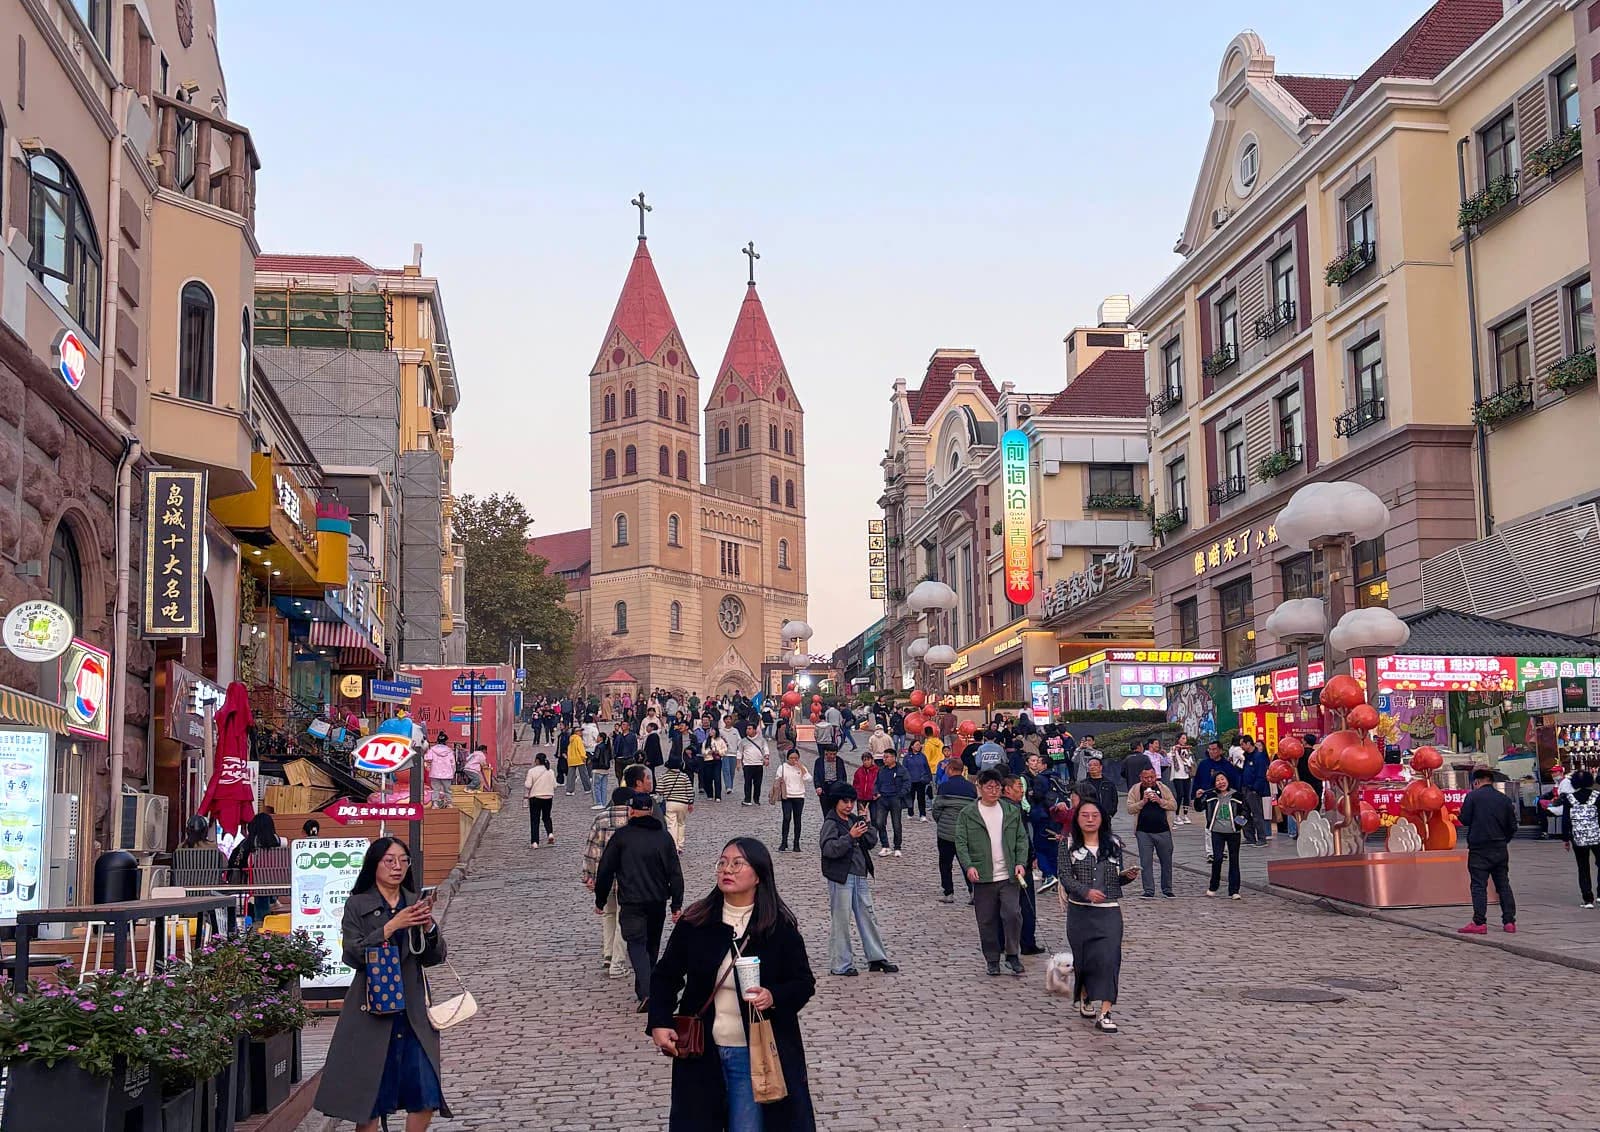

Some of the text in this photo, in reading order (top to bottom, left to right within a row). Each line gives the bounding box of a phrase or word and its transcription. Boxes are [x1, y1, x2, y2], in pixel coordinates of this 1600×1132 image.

[1007, 440, 1026, 510] 前海沿
[161, 484, 186, 622] 岛城十大名吃
[1009, 528, 1030, 591] 青岛菜
[364, 742, 404, 765] DQ
[338, 806, 358, 817] DQ
